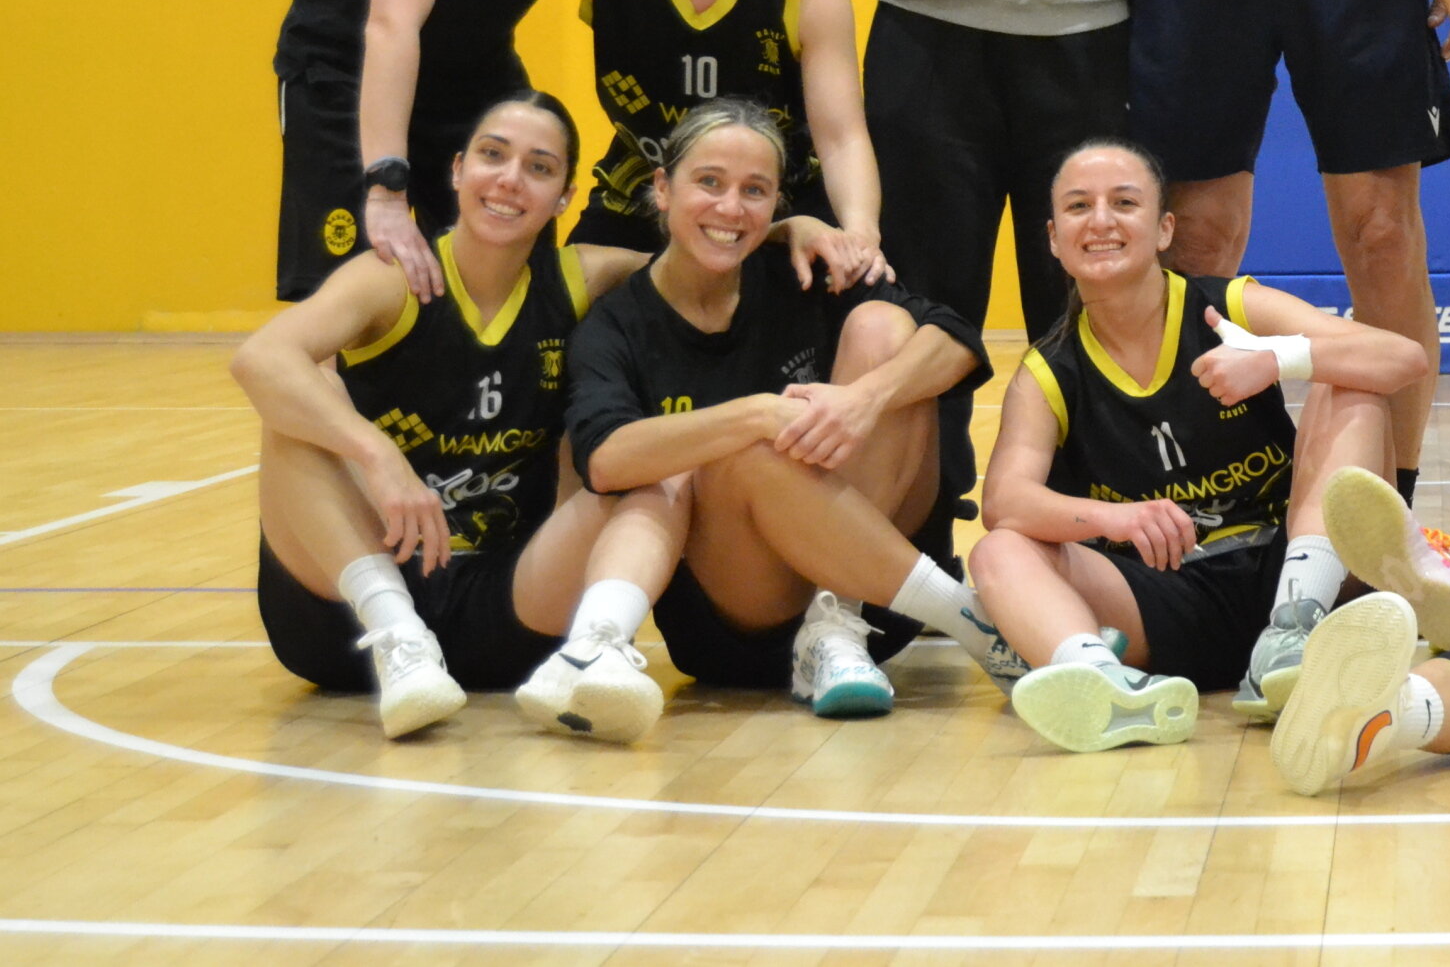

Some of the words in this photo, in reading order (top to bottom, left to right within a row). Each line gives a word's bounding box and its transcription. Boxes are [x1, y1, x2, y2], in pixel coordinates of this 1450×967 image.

[681, 54, 718, 98] 10
[1140, 441, 1286, 502] WAMGROU
[1151, 421, 1188, 472] 11
